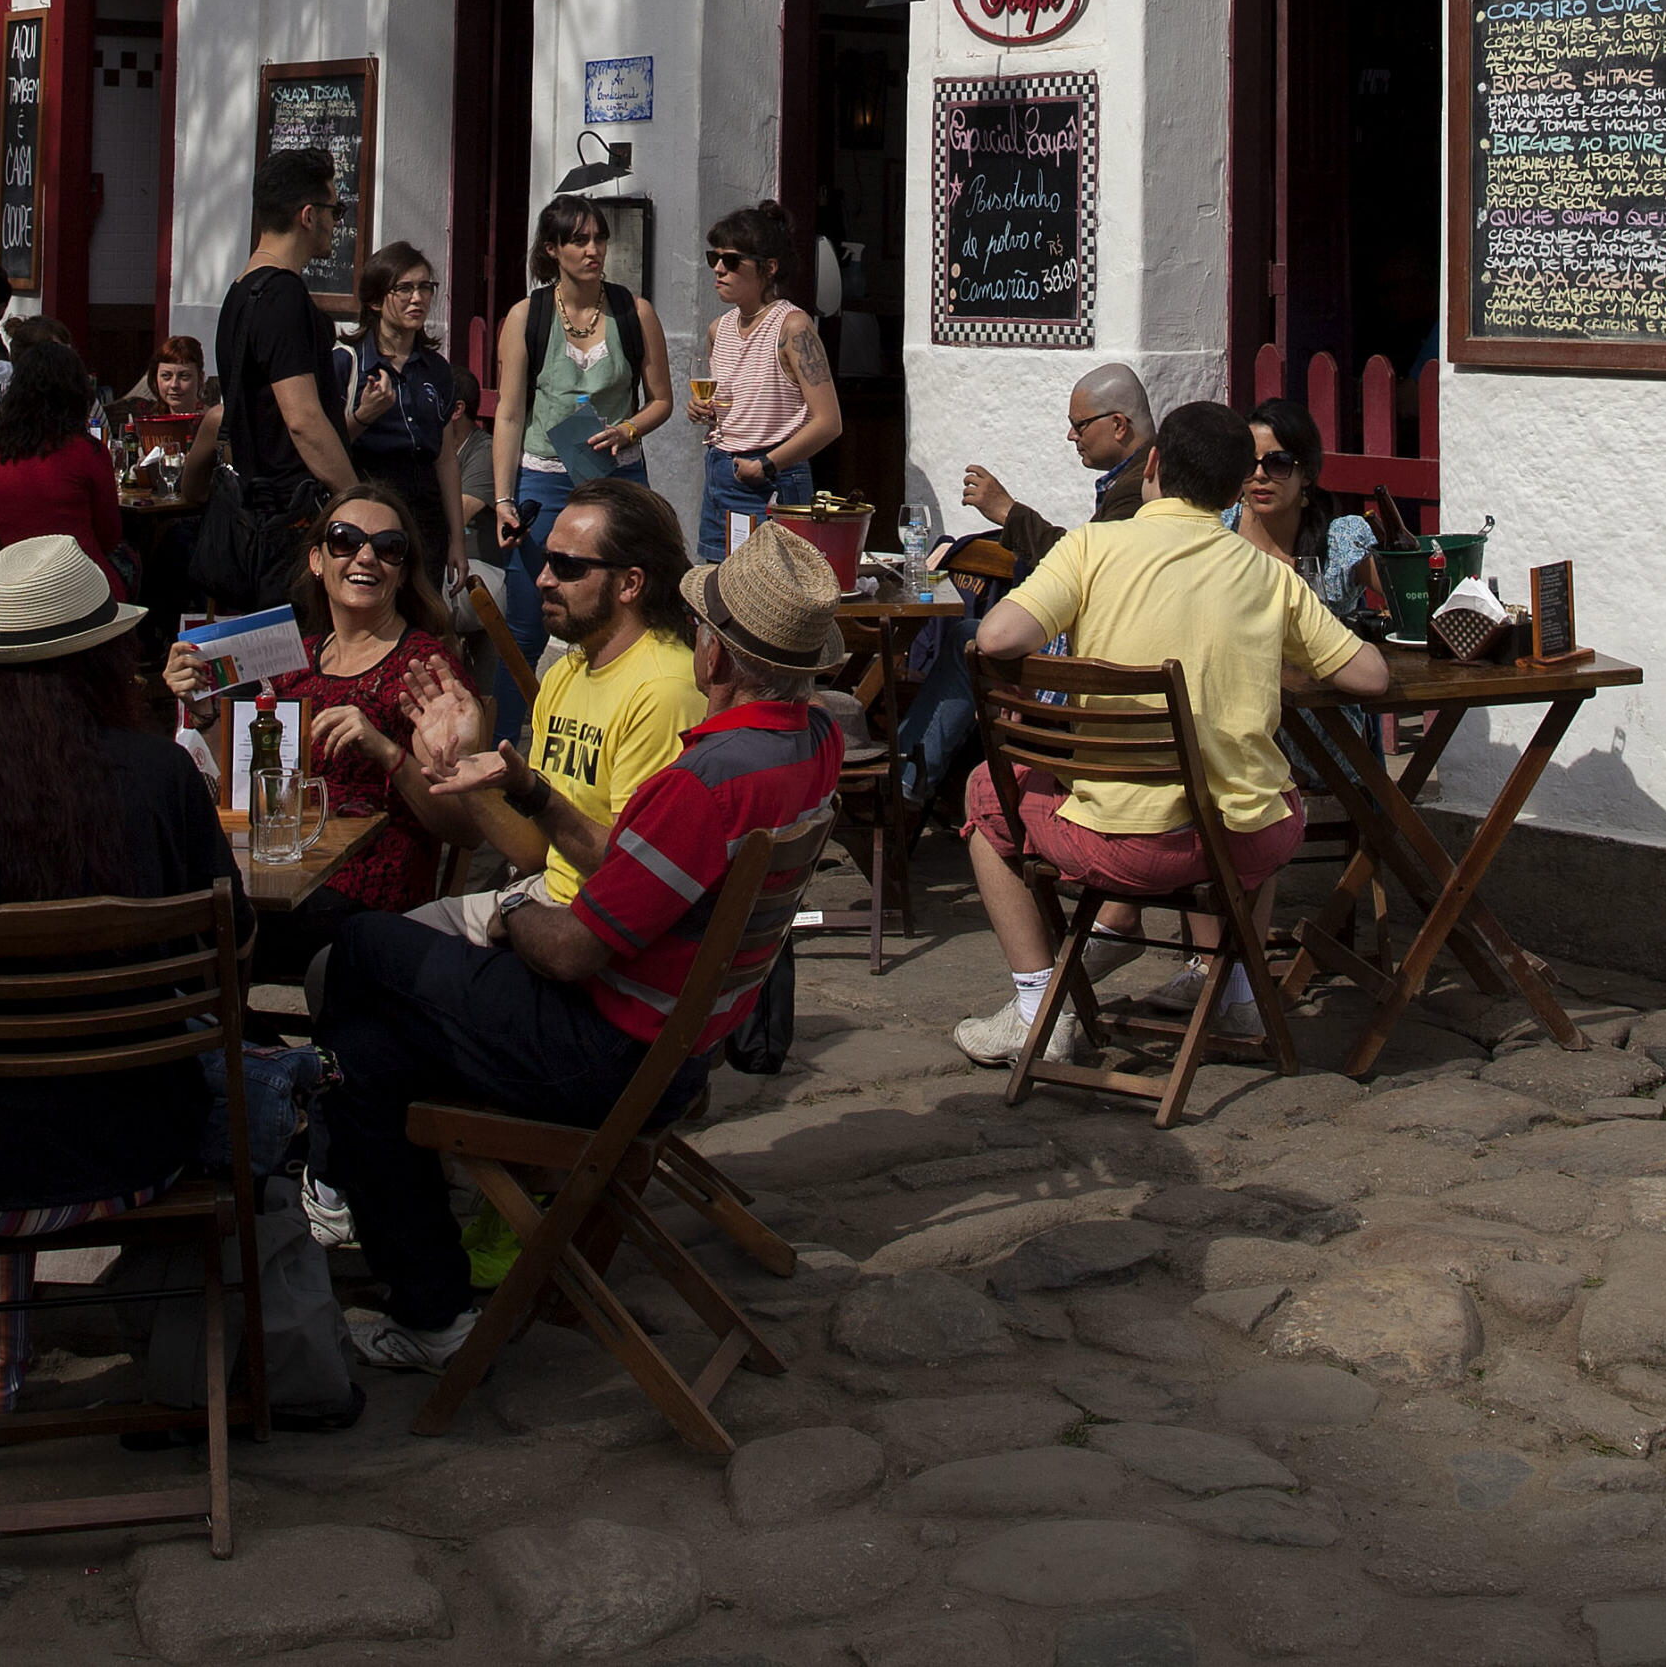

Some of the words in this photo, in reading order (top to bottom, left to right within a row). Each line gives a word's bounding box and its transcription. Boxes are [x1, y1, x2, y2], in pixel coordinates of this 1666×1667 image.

[1487, 0, 1587, 21] CORDEIRO
[1488, 15, 1596, 35] HAMBURGUER
[1600, 16, 1617, 30] DE
[11, 24, 37, 68] AQUI
[1484, 34, 1558, 49] CORDEIRO
[1490, 72, 1577, 94] BURGUER
[1583, 68, 1655, 88] SHITAKE
[275, 86, 309, 103] SALADA
[1485, 92, 1585, 108] HAMBURGUER
[1488, 106, 1564, 120] EMPANADO
[1568, 105, 1580, 116] E
[1582, 102, 1661, 118] RECHEADO
[17, 109, 24, 138] É
[1540, 119, 1589, 132] TOMATE
[1591, 119, 1602, 130] E
[1604, 118, 1649, 132] MOLHO
[949, 105, 1026, 167] Especial
[1492, 133, 1575, 154] BURGUER
[1578, 135, 1602, 152] AO
[5, 144, 32, 186] CASA
[1487, 155, 1579, 170] HAMBURGUER
[1640, 153, 1661, 167] NA
[1487, 168, 1551, 182] PIMENTA
[1553, 169, 1595, 182] PRETA
[966, 168, 1061, 218] Risotinho
[1485, 183, 1538, 197] QUEIJO
[1486, 197, 1533, 209] MOLHO
[1539, 195, 1607, 210] ESPECIAL
[1489, 208, 1555, 228] QUICHE
[1561, 208, 1620, 226] QUATRO
[1601, 228, 1653, 244] CREME
[962, 229, 978, 259] de
[983, 220, 1029, 275] polvo
[1489, 242, 1575, 259] PROVOLONE
[1576, 244, 1589, 257] E
[1484, 257, 1538, 270] SALADA
[1542, 257, 1560, 270] DE
[1496, 271, 1569, 287] SALADA
[1575, 271, 1647, 291] CAESAR
[1492, 285, 1545, 299] ALFACE
[1485, 298, 1600, 316] CARAMELIZADOS
[1484, 311, 1526, 326] MOLHO
[1646, 319, 1657, 331] E
[1405, 591, 1429, 600] open
[548, 715, 577, 738] WE
[578, 723, 605, 747] CAN
